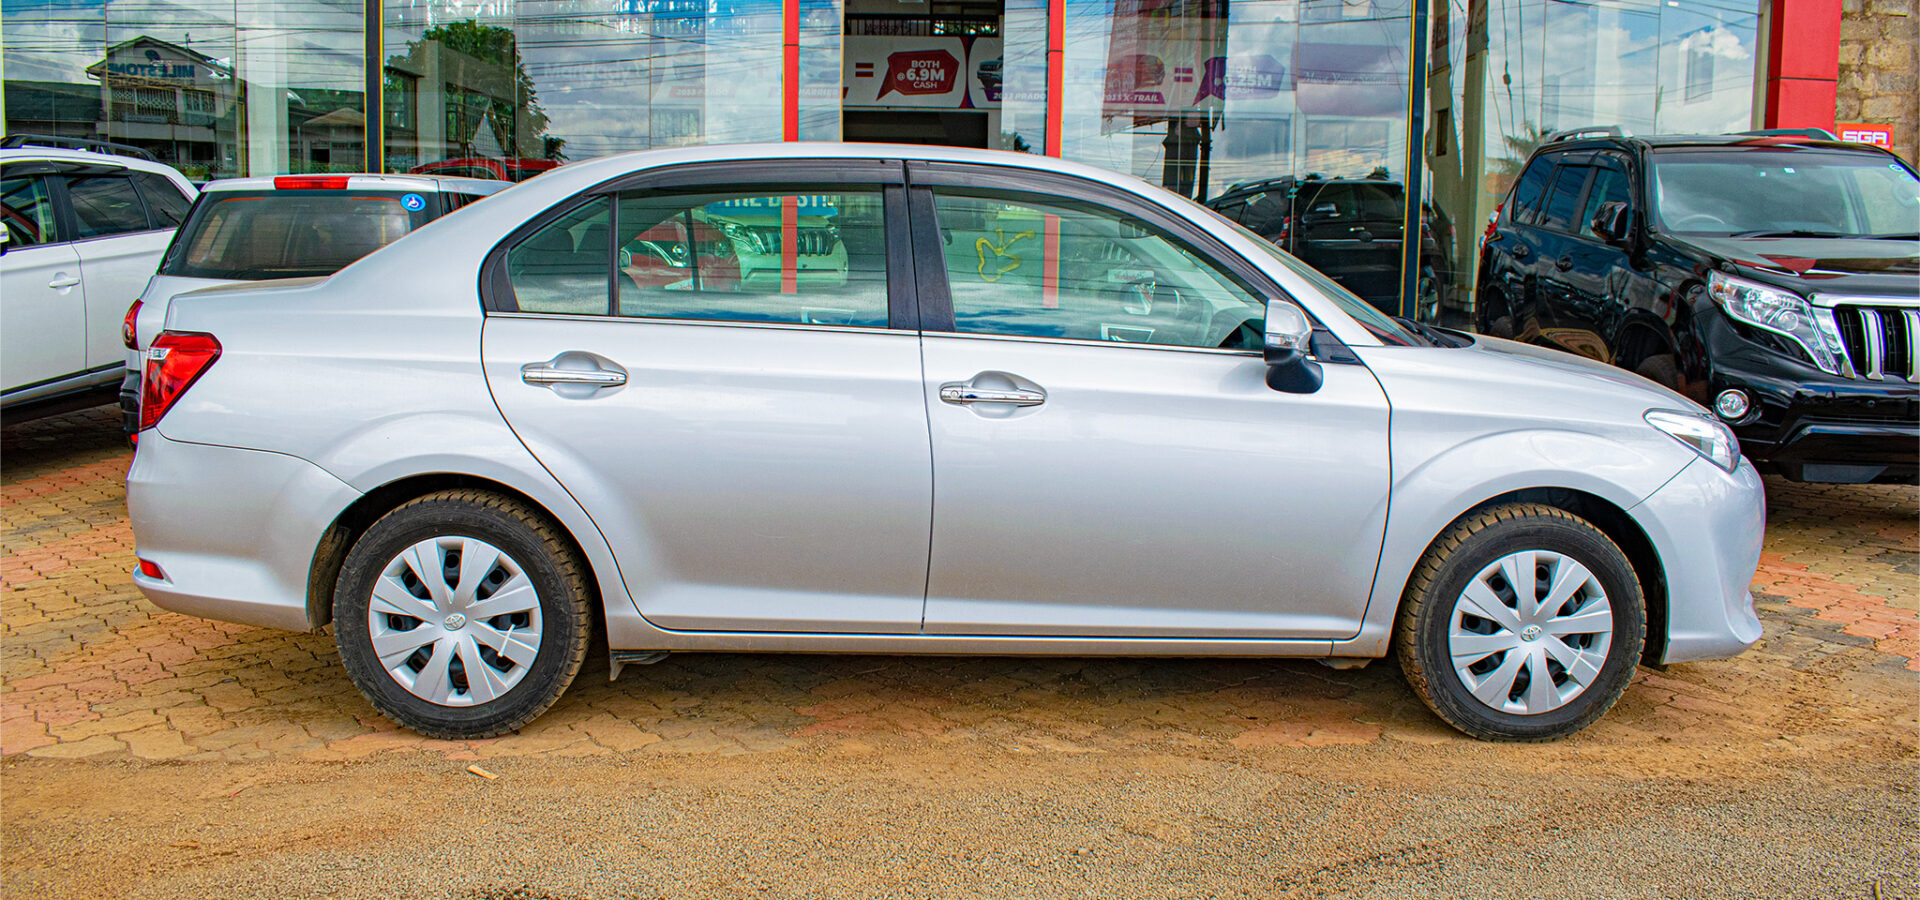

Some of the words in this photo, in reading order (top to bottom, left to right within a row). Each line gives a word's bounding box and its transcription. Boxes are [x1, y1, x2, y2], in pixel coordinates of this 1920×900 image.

[911, 60, 940, 69] BOTH
[913, 80, 938, 89] CASH
[1842, 130, 1888, 143] SGA
